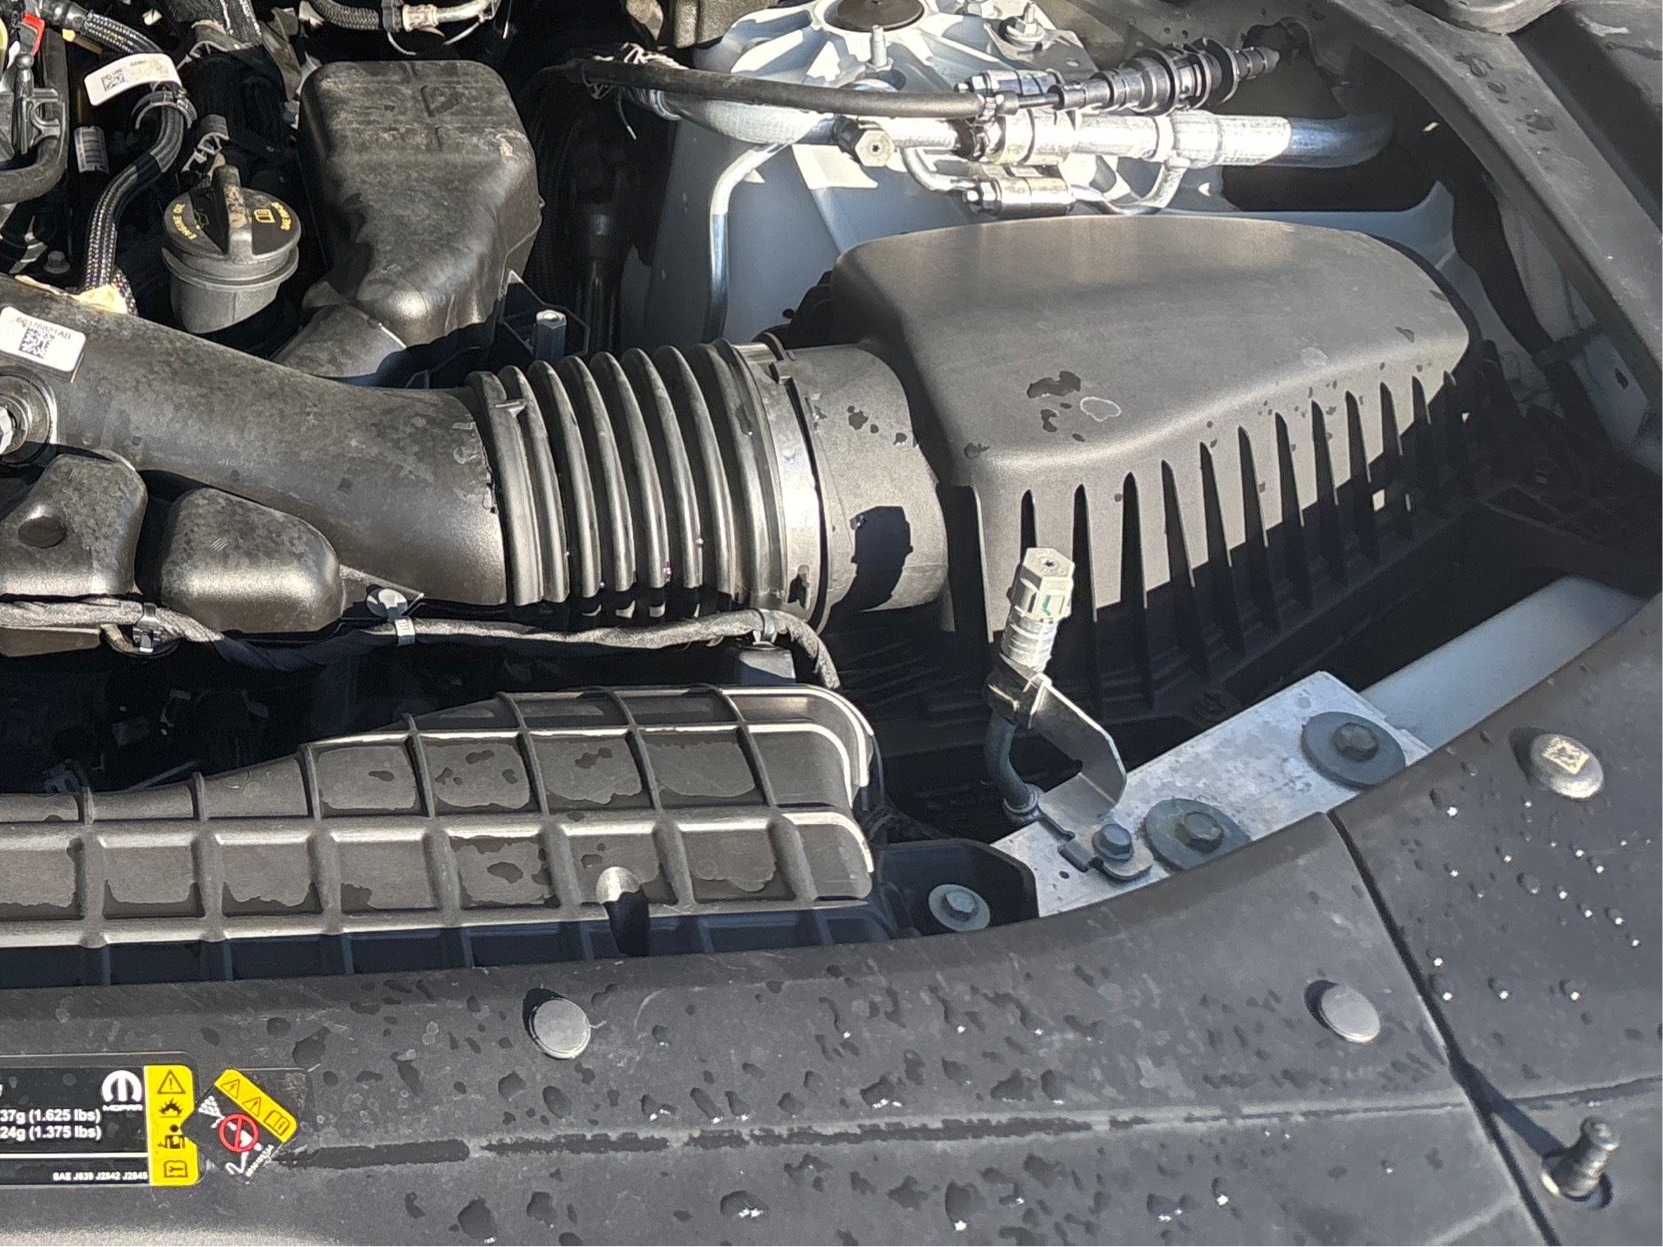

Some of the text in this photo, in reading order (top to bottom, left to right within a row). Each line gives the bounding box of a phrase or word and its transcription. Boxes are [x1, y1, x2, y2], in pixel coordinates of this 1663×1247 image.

[29, 1108, 71, 1125] (1.625
[74, 1108, 101, 1124] lbs)
[29, 1125, 72, 1141] (1.375
[74, 1125, 102, 1141] lbs)
[52, 1171, 71, 1181] SAE
[95, 1171, 121, 1181] J2842
[122, 1171, 148, 1180] J2845
